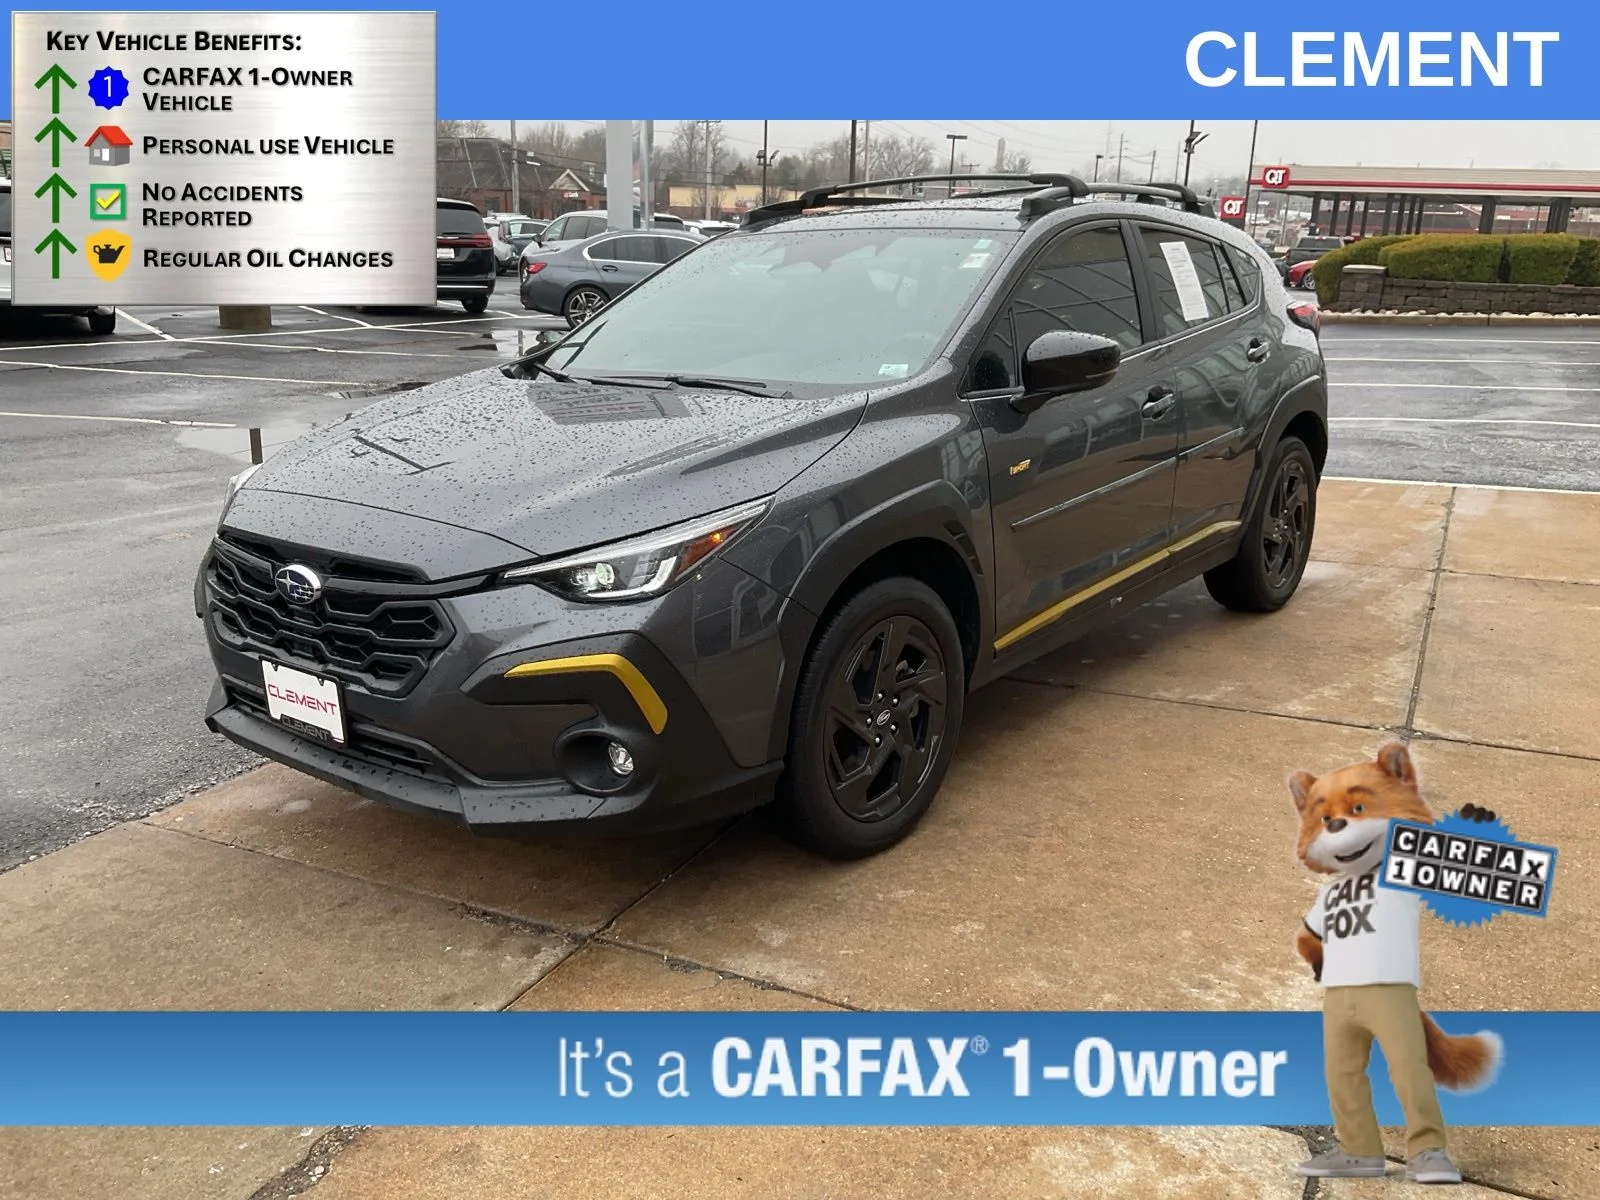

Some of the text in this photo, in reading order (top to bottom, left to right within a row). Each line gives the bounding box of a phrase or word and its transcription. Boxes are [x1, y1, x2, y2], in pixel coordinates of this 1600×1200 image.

[1264, 168, 1286, 186] QT
[1223, 199, 1244, 215] QT
[267, 684, 337, 716] CLEMENT
[281, 716, 329, 741] CLEMENT
